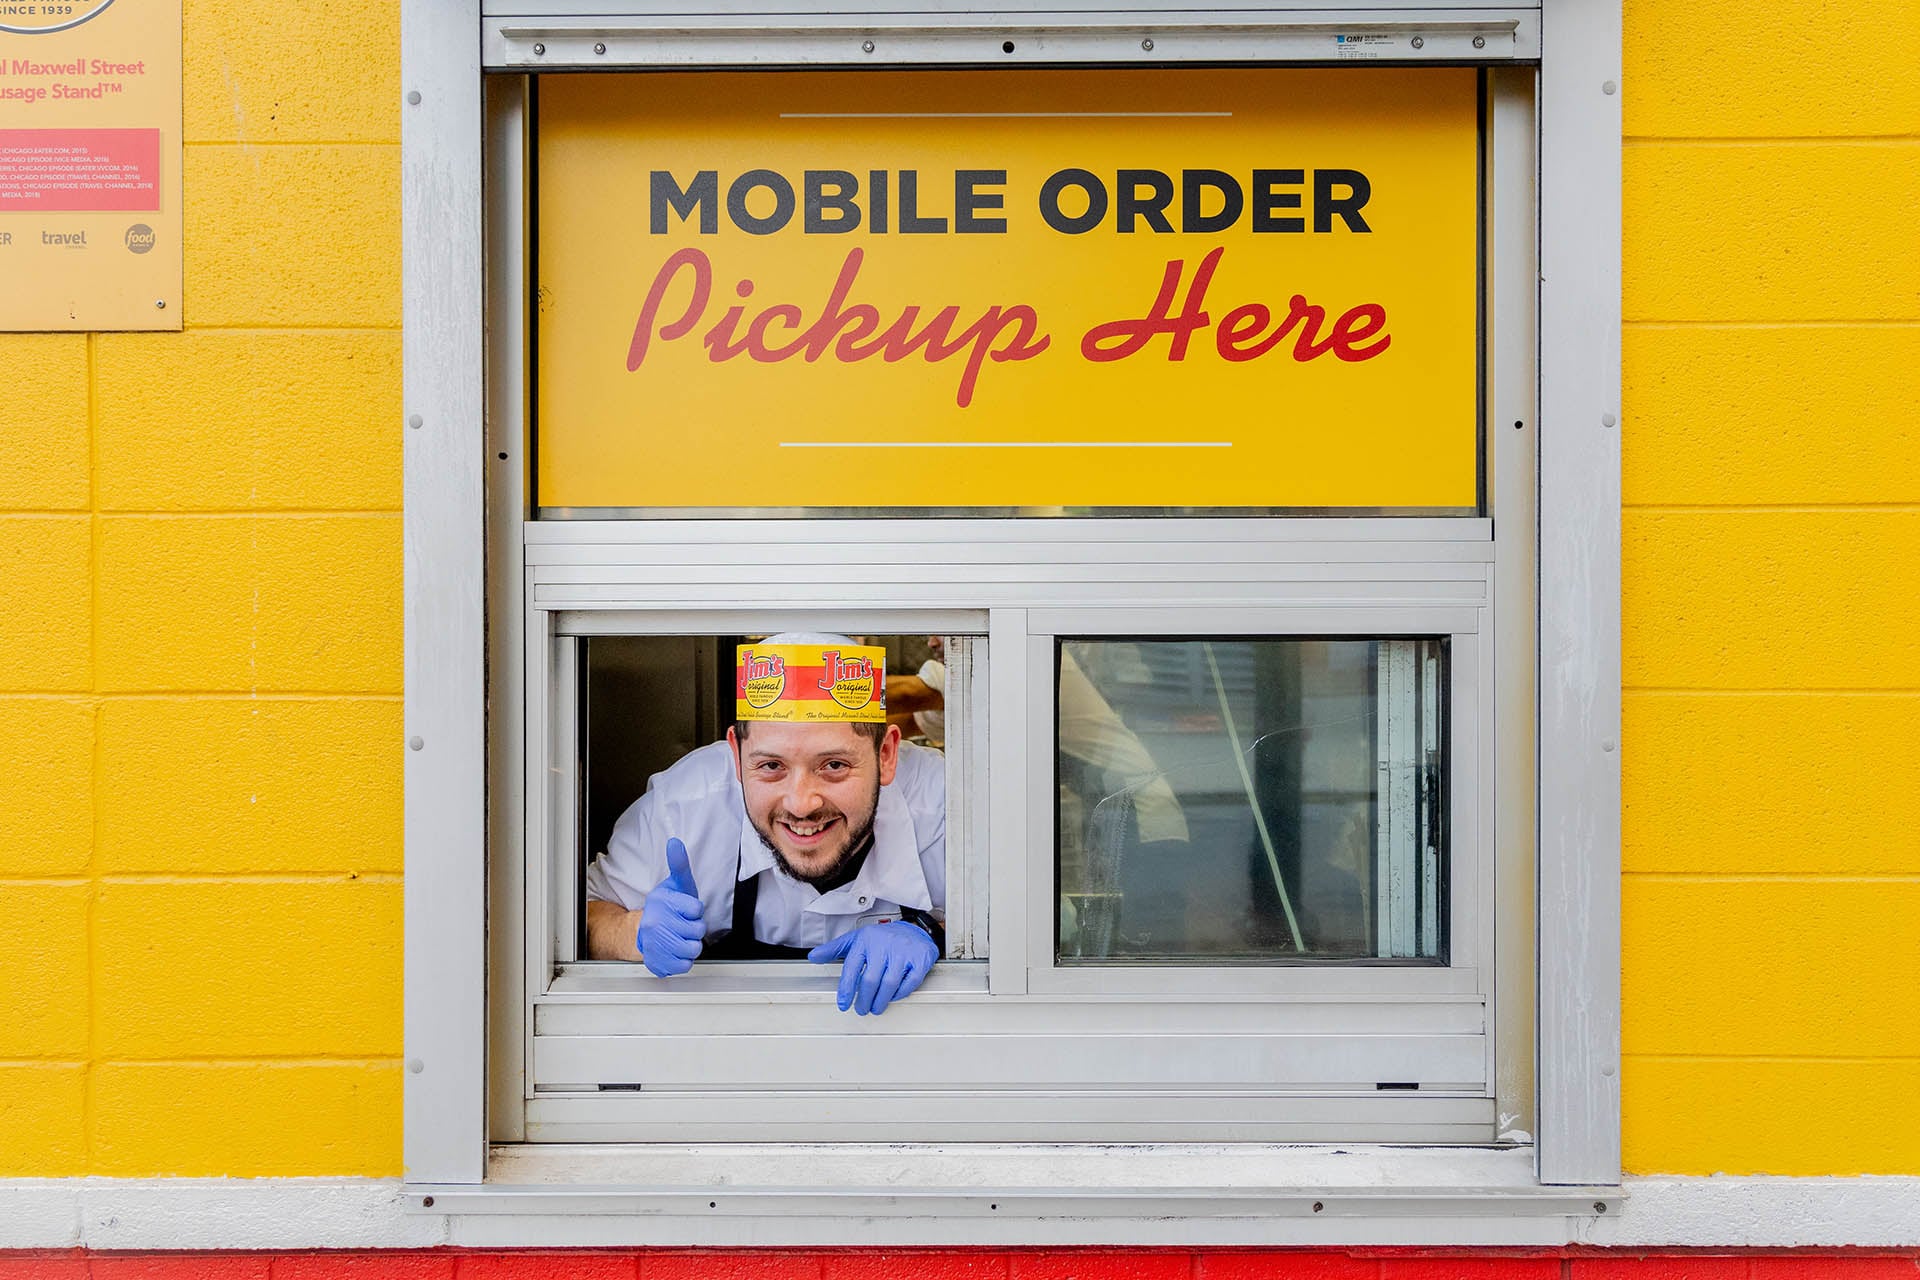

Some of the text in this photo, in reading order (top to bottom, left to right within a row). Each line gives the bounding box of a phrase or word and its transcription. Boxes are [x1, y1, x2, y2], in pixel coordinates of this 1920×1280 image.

[41, 6, 73, 15] 1939
[12, 58, 86, 75] Maxwell
[90, 59, 145, 75] Street
[650, 168, 1373, 235] MOBILE ORDER
[41, 231, 87, 245] travel
[127, 230, 155, 246] food
[626, 246, 1392, 409] Pickup Here
[741, 650, 785, 689] Jim's
[818, 650, 874, 691] Jim's
[836, 681, 873, 695] original
